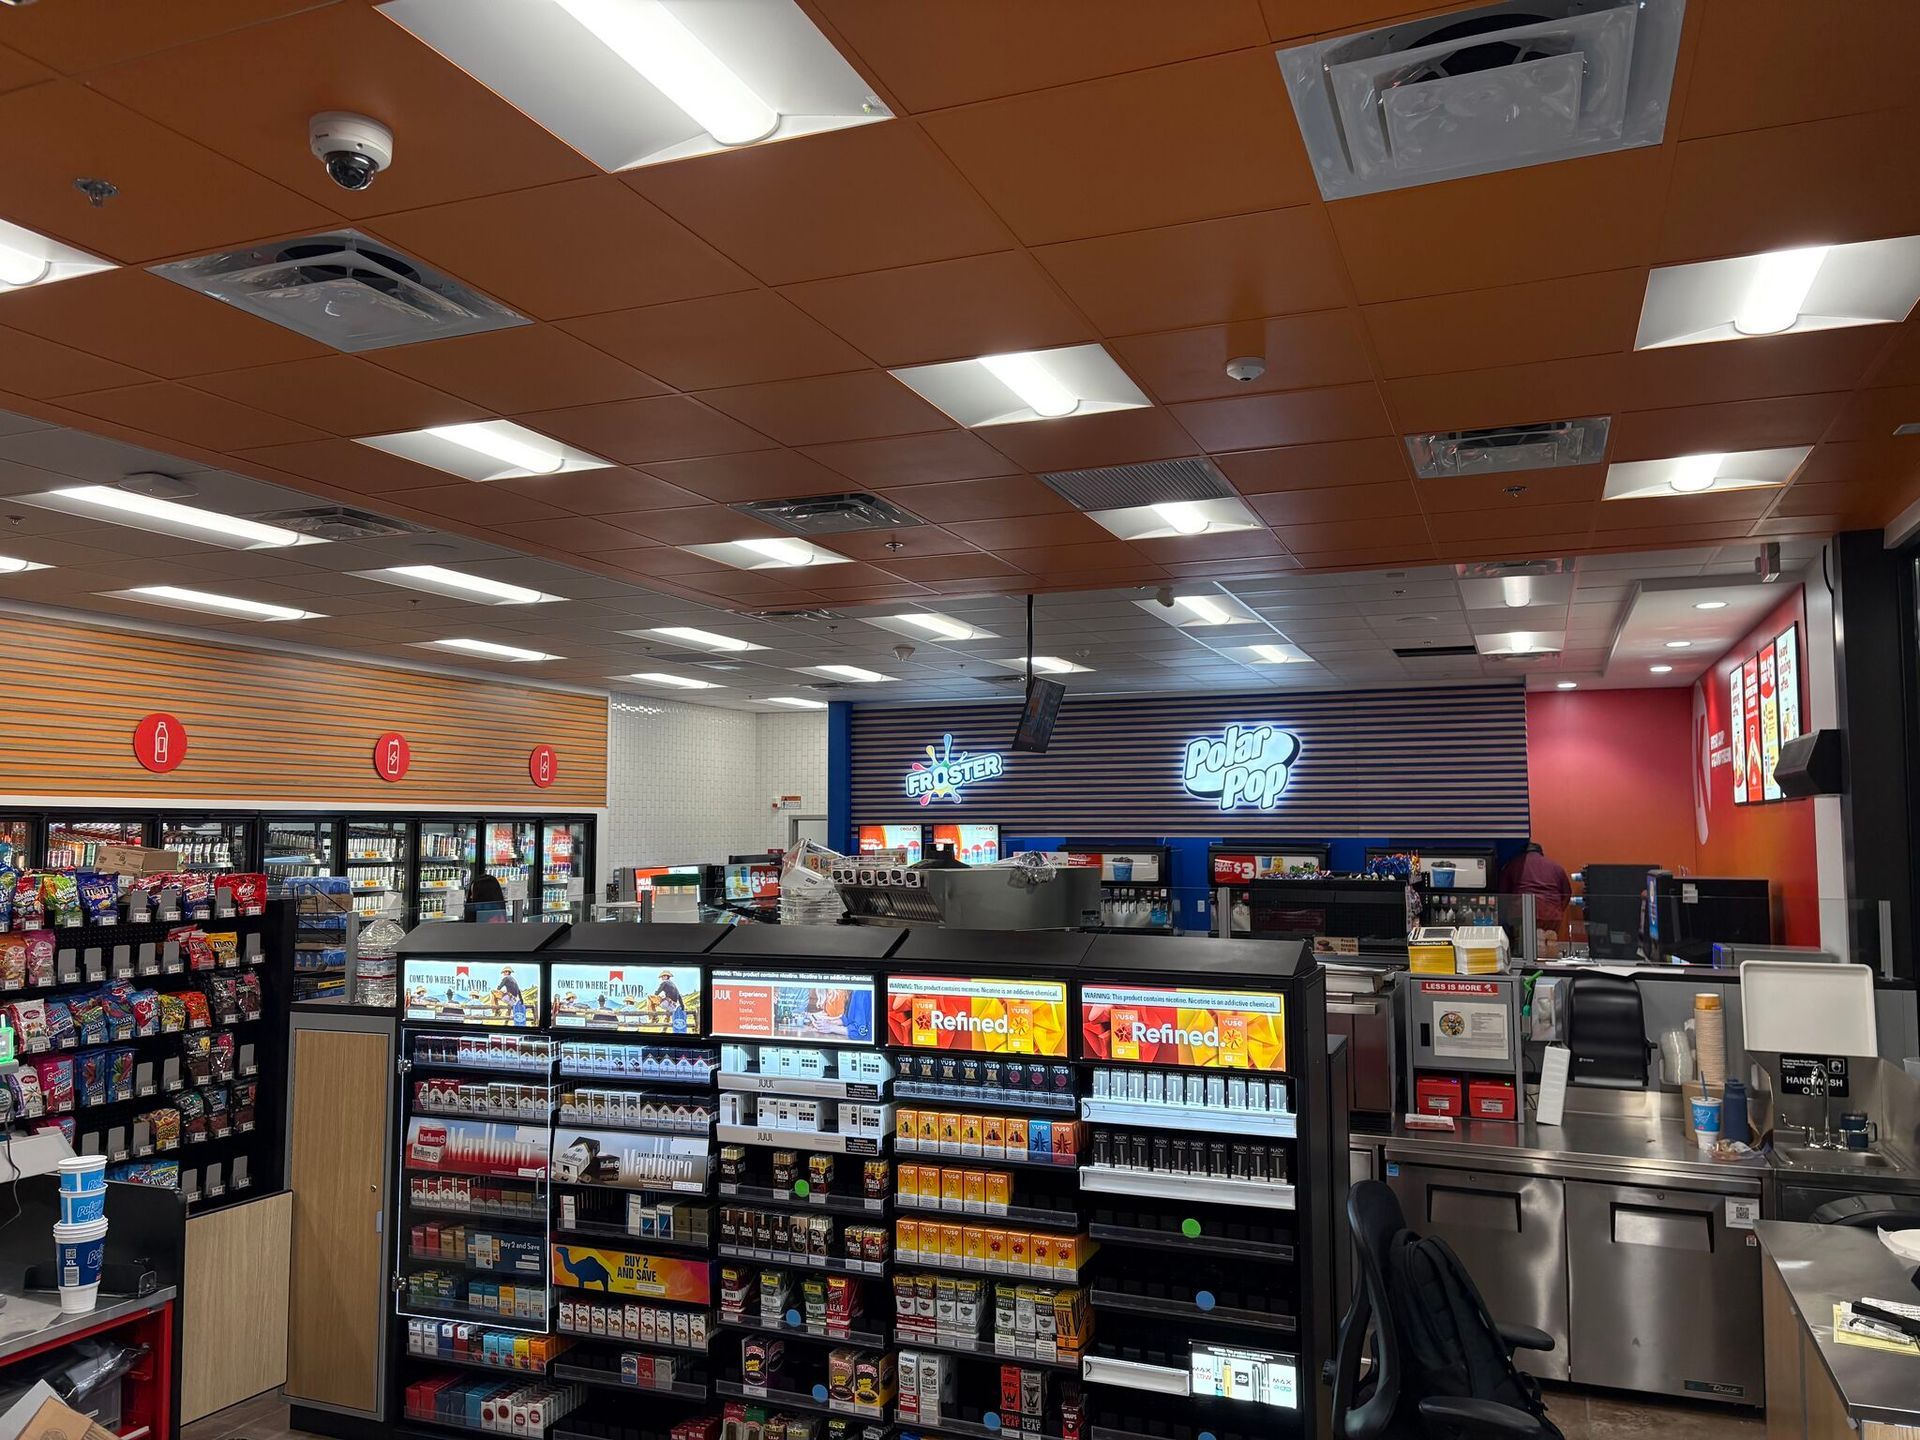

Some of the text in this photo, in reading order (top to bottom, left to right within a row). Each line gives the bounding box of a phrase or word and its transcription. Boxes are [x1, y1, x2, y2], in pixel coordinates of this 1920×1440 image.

[1184, 725, 1272, 780] Polar
[907, 755, 999, 796] FROSTER
[1220, 762, 1288, 811] Pop
[1233, 862, 1255, 879] $3
[409, 974, 456, 985] COME TO WHERE
[557, 980, 608, 990] COME TO WHERE
[738, 990, 768, 998] Experience
[914, 983, 923, 991] This
[1013, 988, 1034, 996] addictive
[1112, 993, 1122, 1001] This
[1123, 994, 1143, 1002] product
[1188, 997, 1210, 1005] Nicotine
[1224, 999, 1249, 1007] addictive
[930, 1010, 1015, 1034] Refined.
[1131, 1022, 1227, 1048] Refined.
[758, 1078, 775, 1088] JUUL
[1816, 1078, 1843, 1087] WSH
[757, 1132, 774, 1142] JUUL
[447, 1122, 531, 1166] Marlboro
[622, 1137, 693, 1180] Marlboro
[639, 1173, 672, 1181] BLACK
[500, 1240, 512, 1248] Buy
[515, 1241, 527, 1249] and
[527, 1242, 540, 1251] Save
[624, 1255, 649, 1269] BUY 2
[617, 1266, 657, 1282] AND SAVE
[829, 1304, 844, 1312] LEAF
[1002, 1420, 1020, 1428] LEAF
[1022, 1423, 1041, 1431] LEAF
